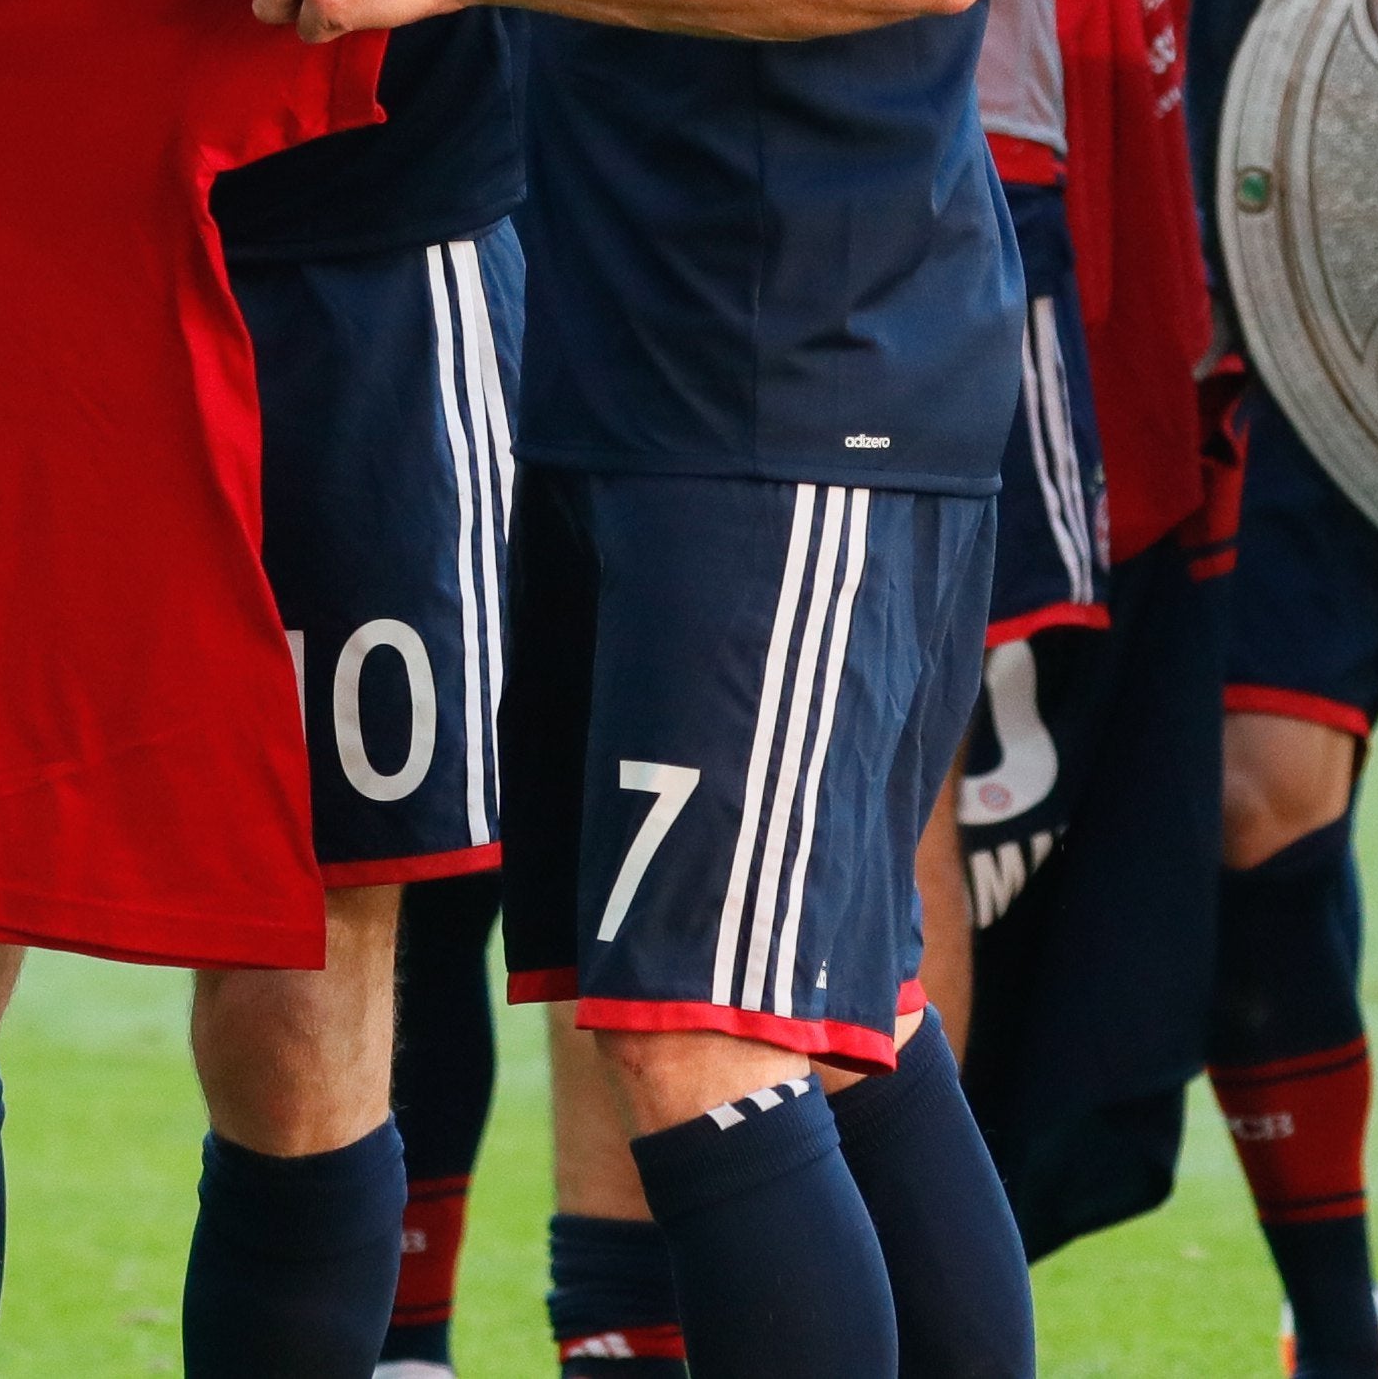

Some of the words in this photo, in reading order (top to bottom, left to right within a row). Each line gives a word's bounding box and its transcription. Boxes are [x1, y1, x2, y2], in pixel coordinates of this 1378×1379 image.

[845, 434, 891, 449] adizero
[285, 618, 438, 802] 0
[596, 760, 701, 943] 7
